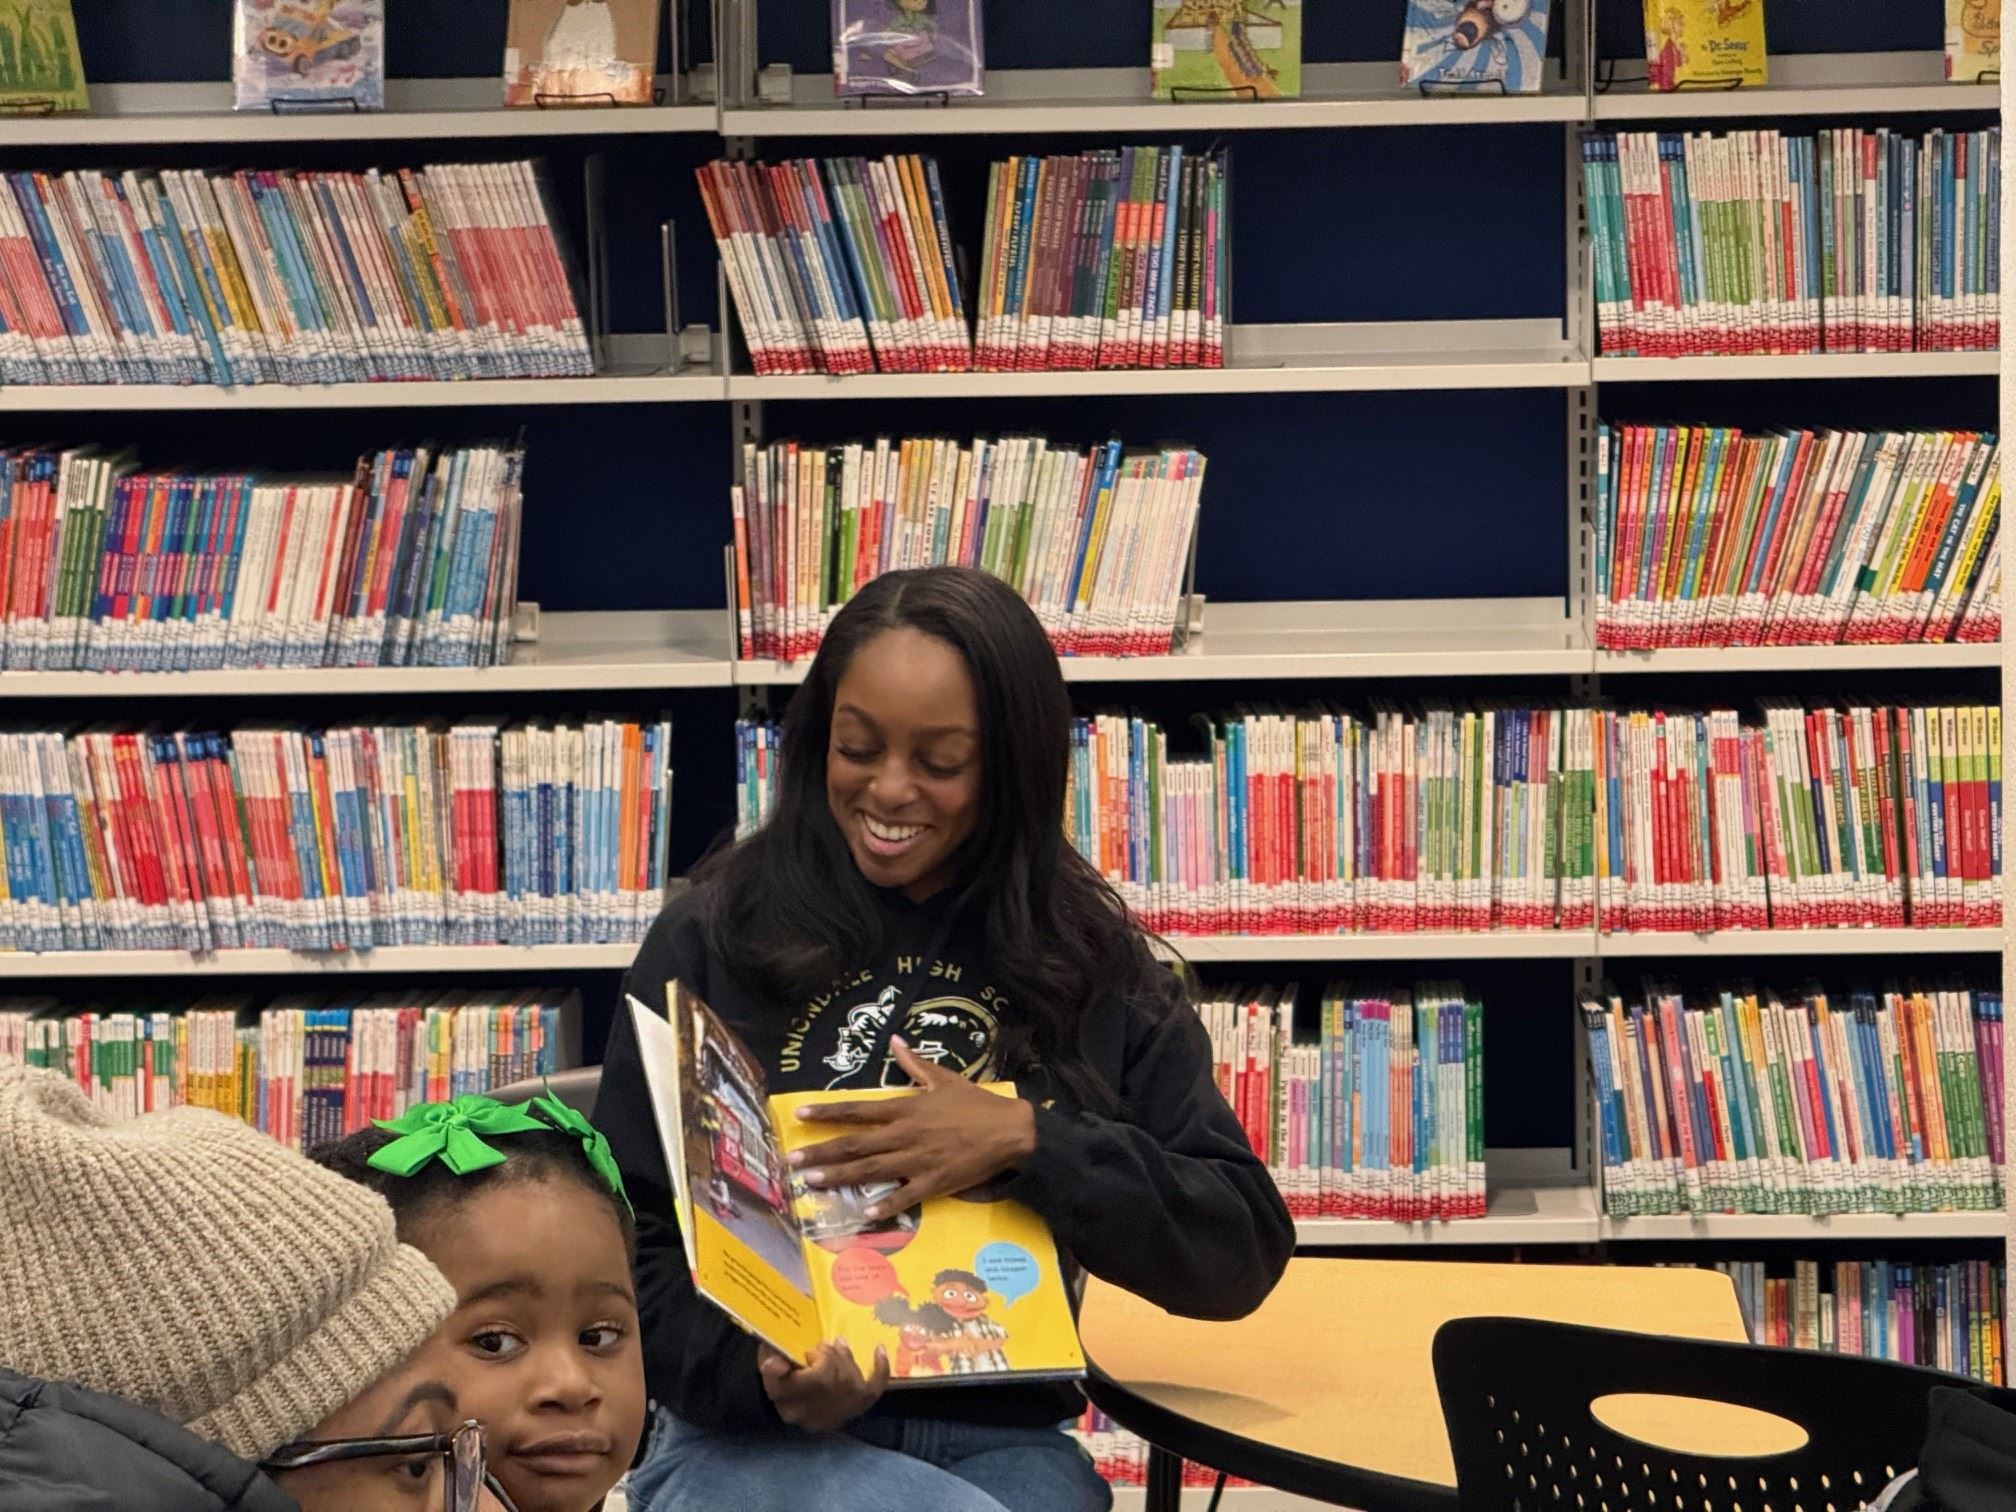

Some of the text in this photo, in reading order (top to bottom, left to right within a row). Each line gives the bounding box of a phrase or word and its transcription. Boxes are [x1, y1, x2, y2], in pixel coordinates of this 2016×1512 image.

[1178, 234, 1186, 261] GHOST
[1192, 235, 1202, 261] GHOST
[1150, 251, 1160, 268] TOO
[1148, 270, 1160, 293] MANY
[1176, 263, 1186, 290] NAMED
[1192, 263, 1200, 290] NAMED
[1955, 503, 1966, 517] THE
[1949, 518, 1961, 534] CAT
[1940, 546, 1950, 560] THE
[1932, 562, 1945, 579] HAT
[781, 968, 874, 1073] UNIONDLE
[1280, 1080, 1288, 1096] Put
[1278, 1145, 1287, 1162] Zoo
